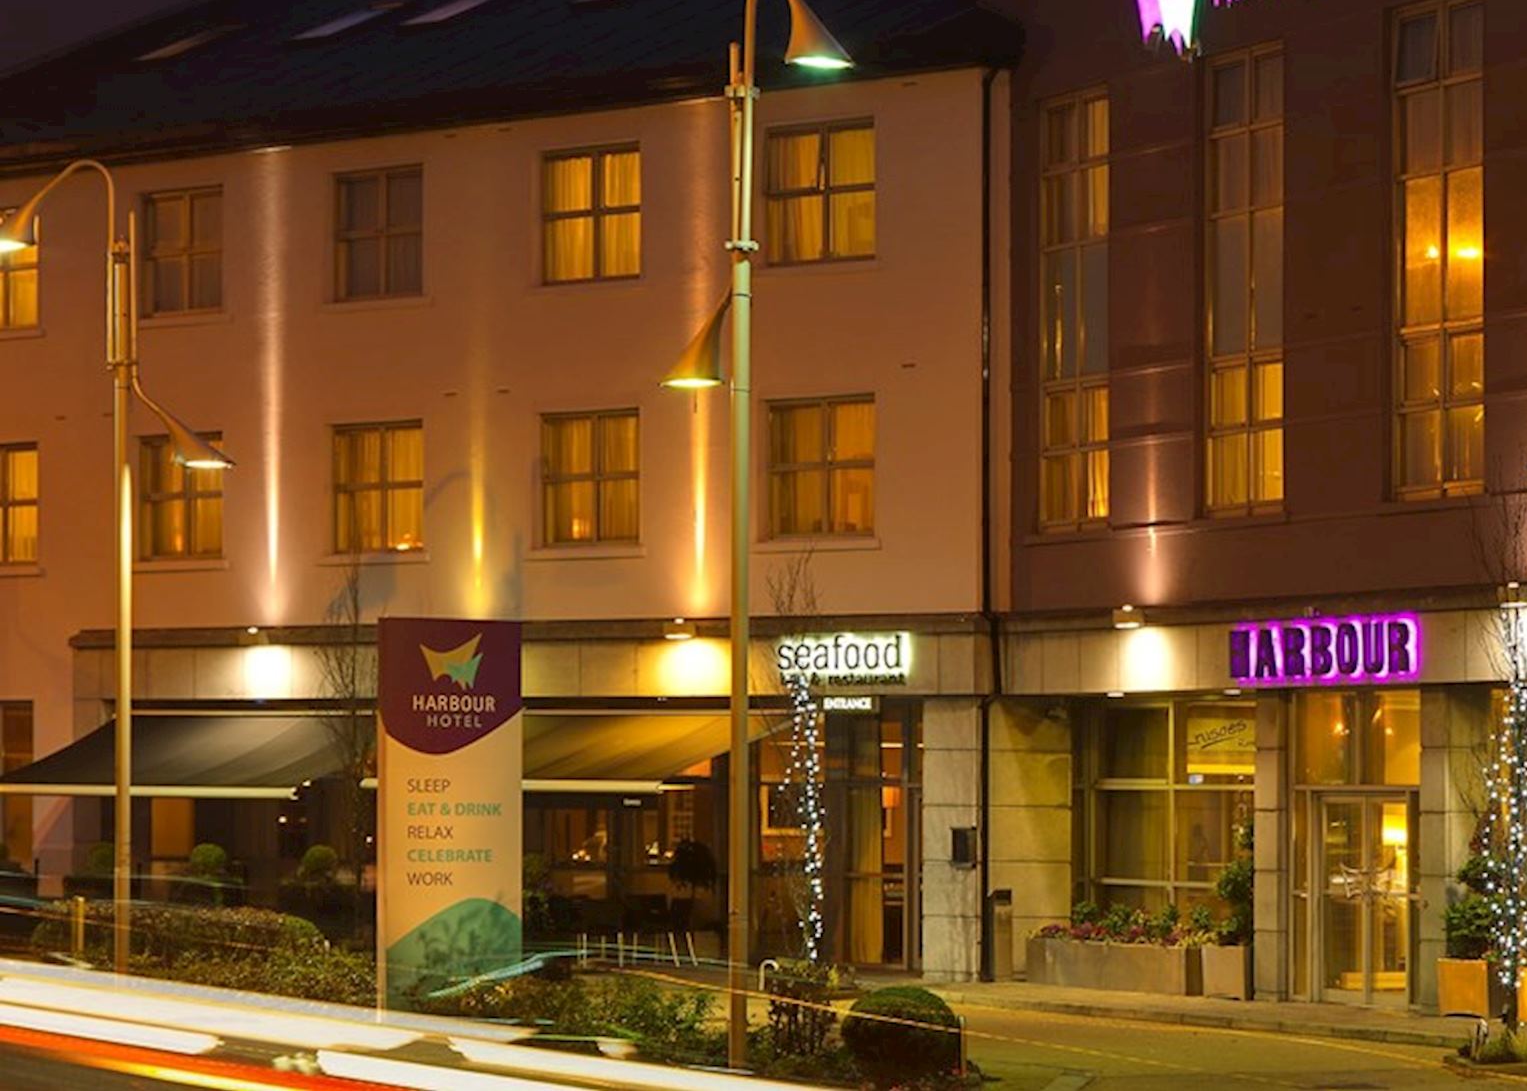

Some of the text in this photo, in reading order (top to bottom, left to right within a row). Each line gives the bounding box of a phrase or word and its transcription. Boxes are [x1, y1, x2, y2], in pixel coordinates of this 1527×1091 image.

[777, 634, 901, 670] seafood
[1229, 621, 1411, 679] HARBOUR
[828, 672, 906, 686] restaurant
[412, 694, 496, 713] HARBOUR
[822, 697, 872, 710] ENTRANCE
[426, 714, 482, 728] HOTEL
[407, 778, 451, 793] SLEEP
[407, 802, 502, 816] EAT & DRINK
[407, 825, 454, 839] RELAX
[407, 848, 493, 863] CELEBRATE
[406, 871, 454, 886] WORK
